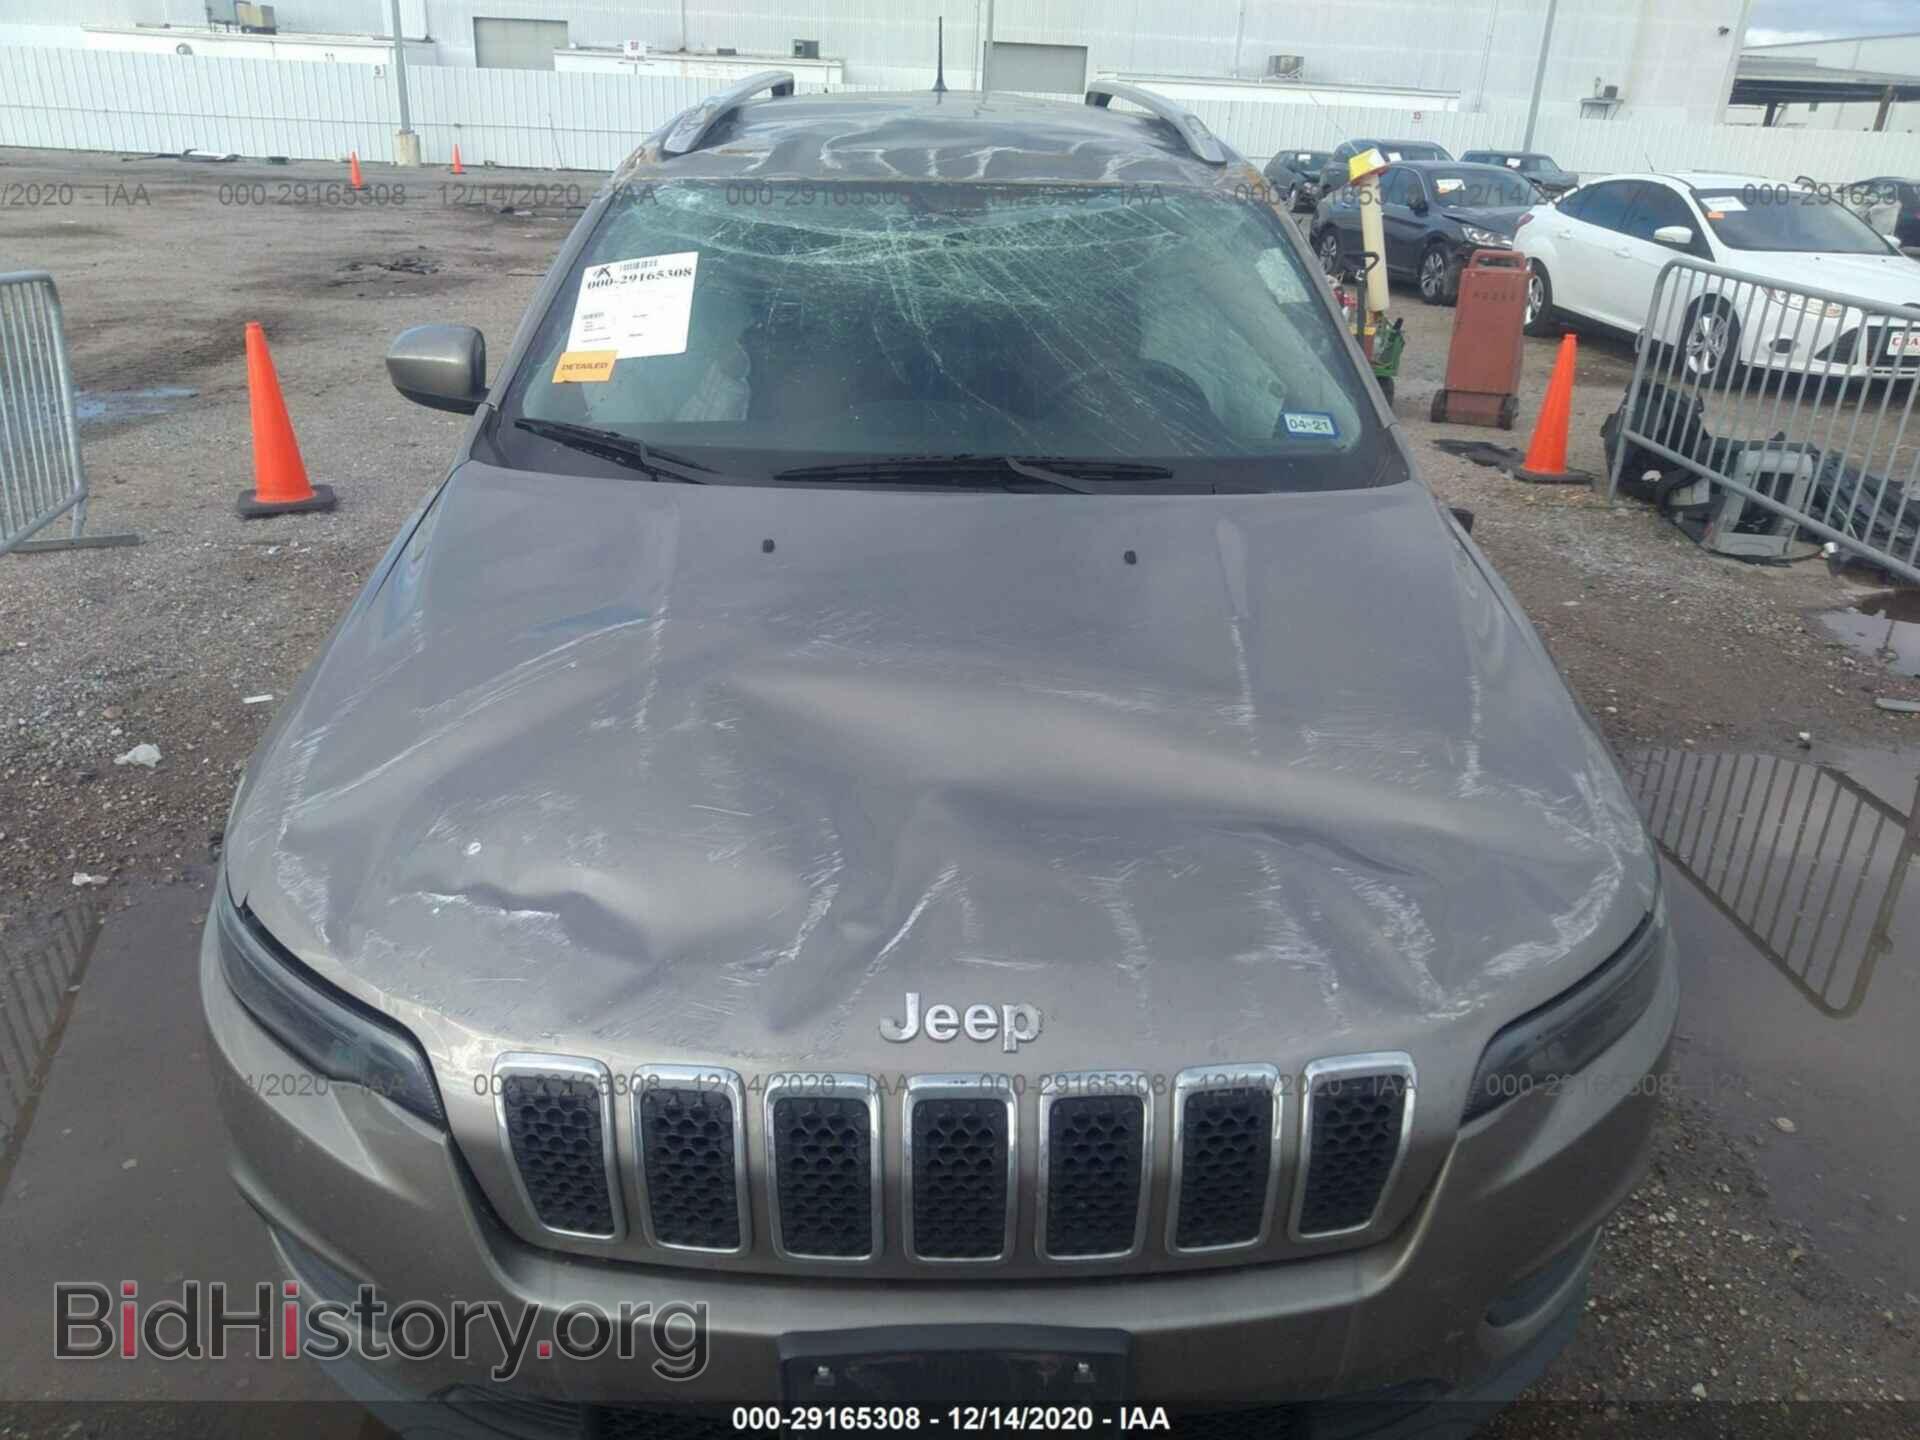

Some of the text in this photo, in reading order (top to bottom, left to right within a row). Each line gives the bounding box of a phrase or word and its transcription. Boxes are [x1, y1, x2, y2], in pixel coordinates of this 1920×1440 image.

[587, 267, 693, 289] 000-29165308
[561, 361, 609, 371] DETAILED
[1289, 418, 1330, 431] 04-21
[879, 991, 1043, 1053] Jeep
